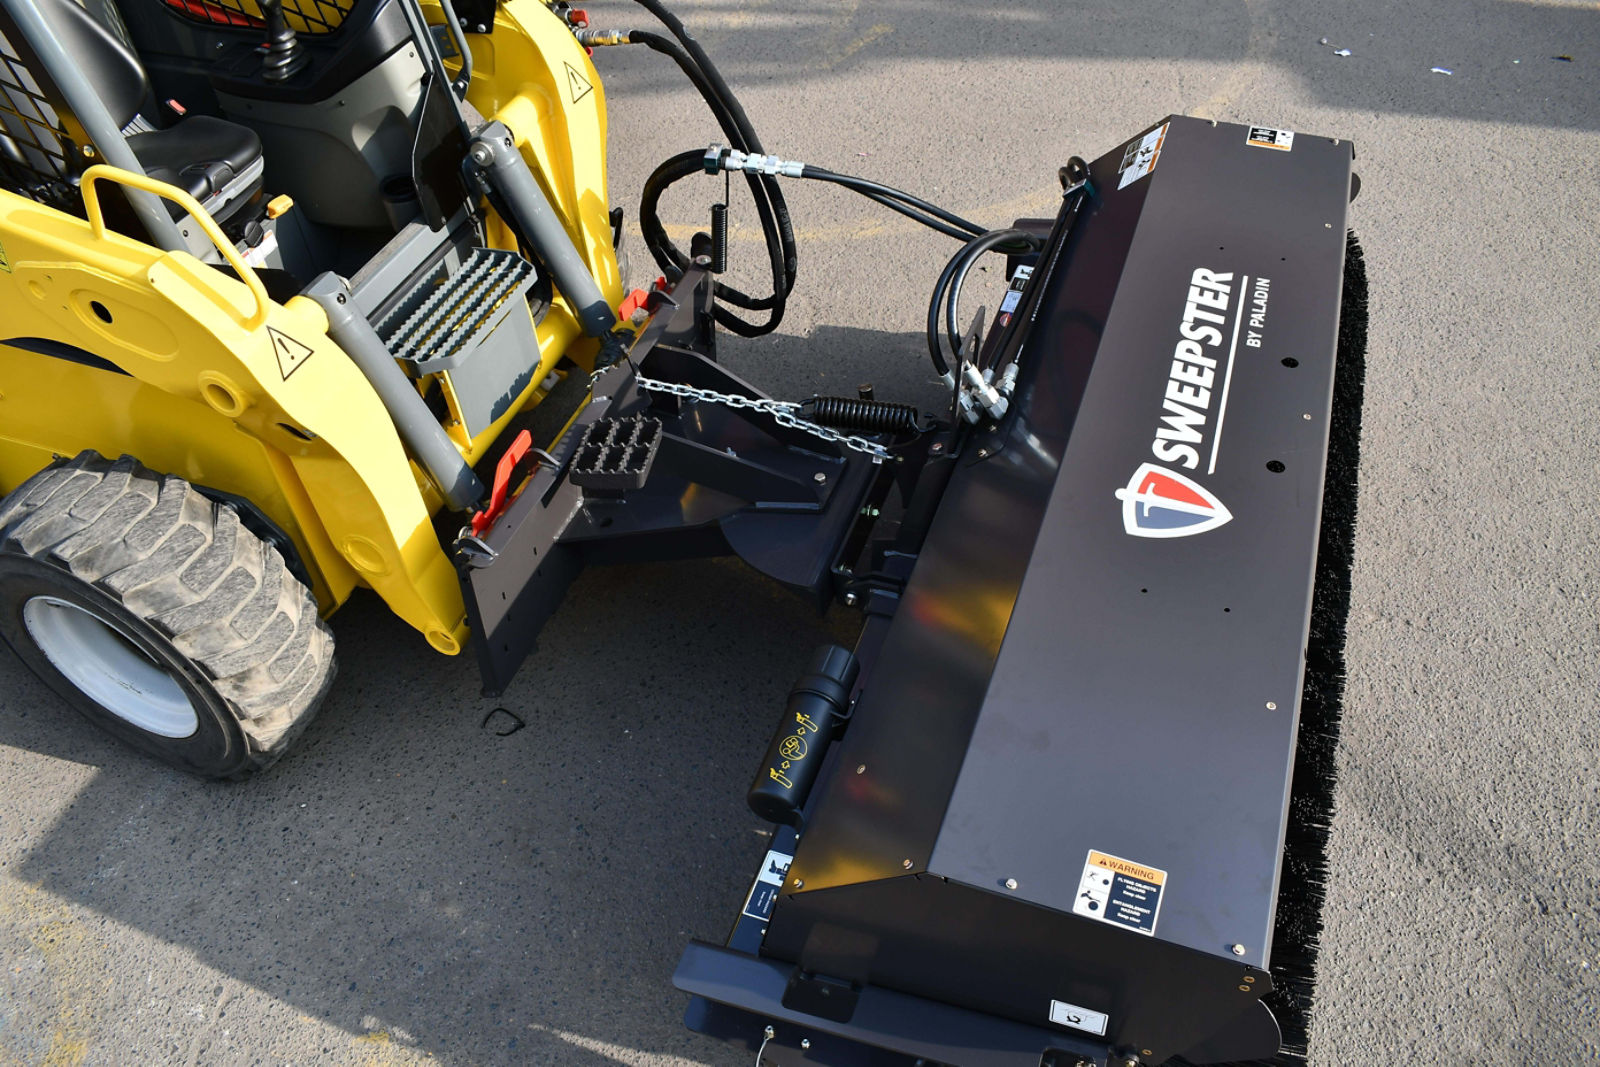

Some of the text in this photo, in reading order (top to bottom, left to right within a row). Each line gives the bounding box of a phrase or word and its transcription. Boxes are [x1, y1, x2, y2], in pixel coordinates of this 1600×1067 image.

[1246, 277, 1270, 348] BY PALADIN
[1152, 267, 1233, 470] SWEEPSTER
[1109, 860, 1154, 880] WARNING
